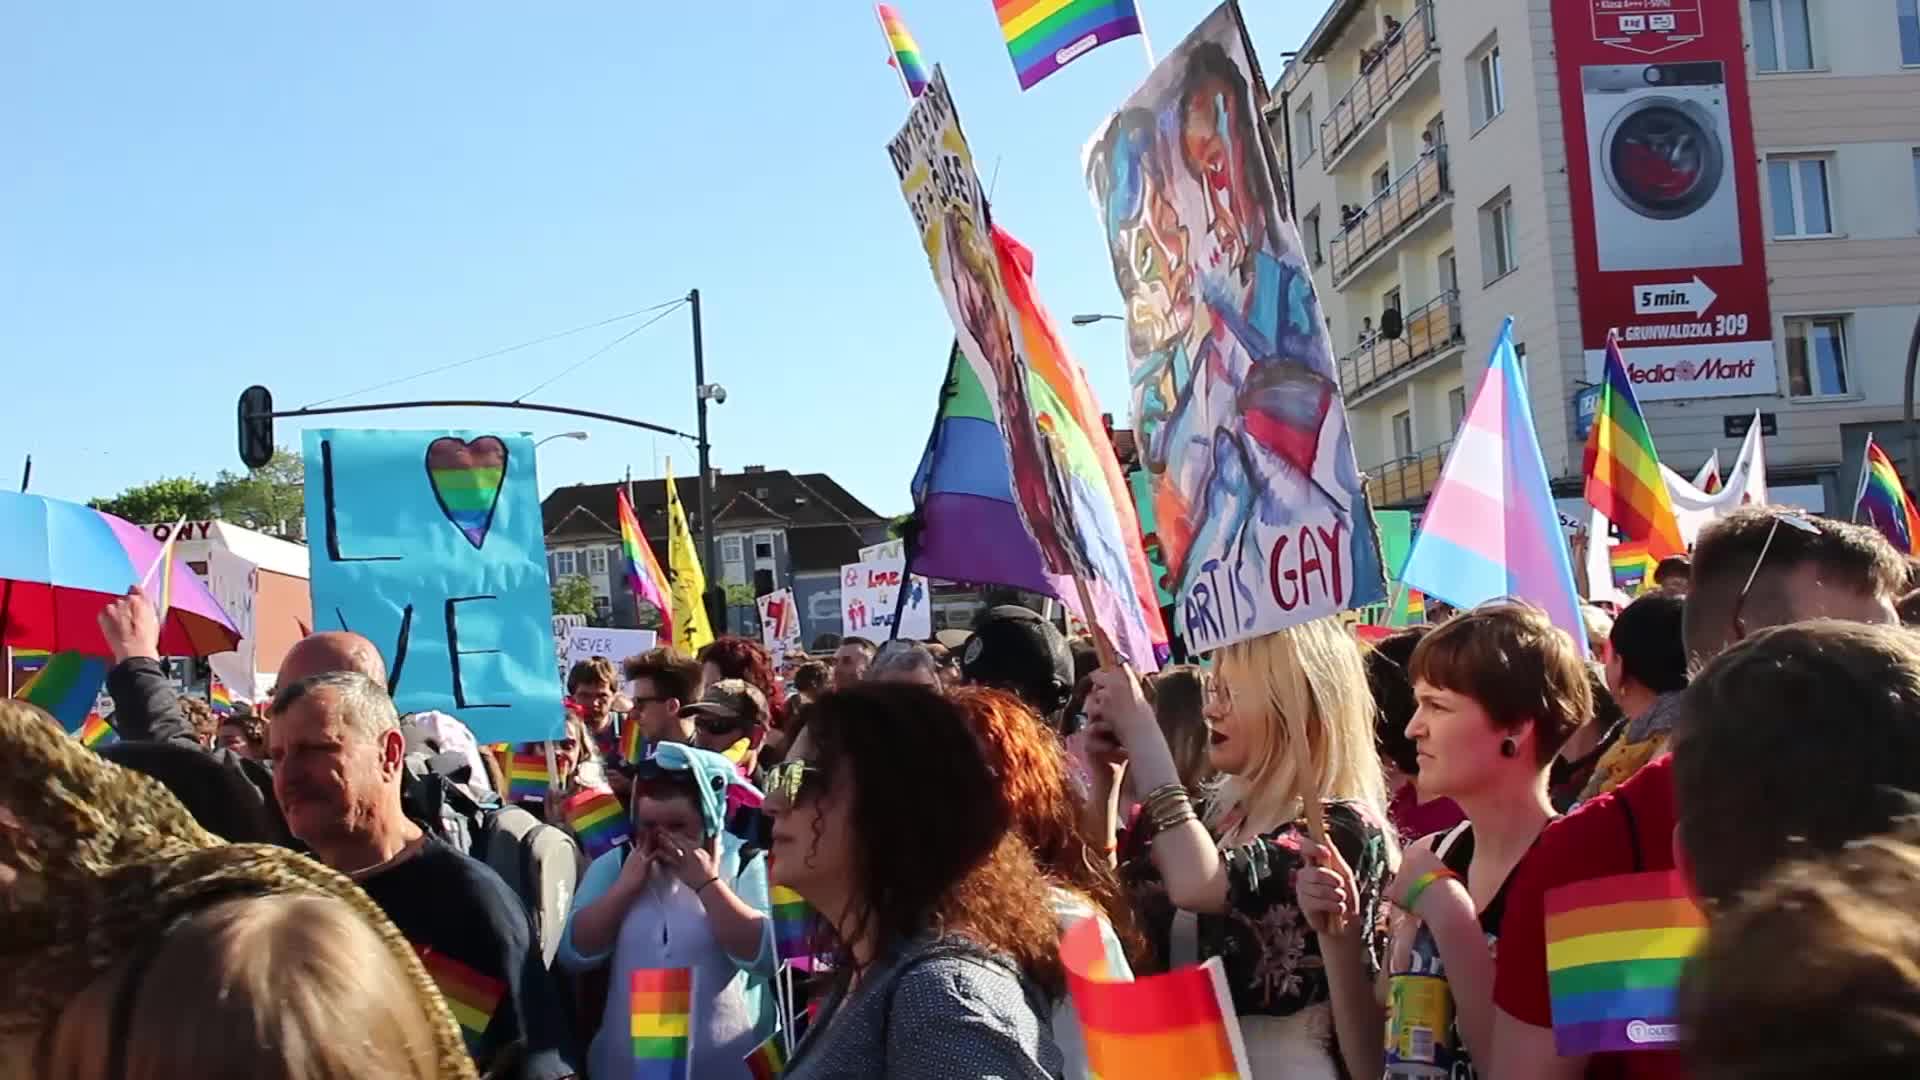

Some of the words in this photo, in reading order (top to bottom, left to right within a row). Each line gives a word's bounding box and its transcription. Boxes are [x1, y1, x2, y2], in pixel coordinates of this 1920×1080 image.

[1641, 291, 1652, 307] 5
[1653, 290, 1690, 306] min.
[1625, 322, 1713, 342] GRUNWALDZKA
[1714, 313, 1748, 337] 309
[1694, 357, 1755, 381] Markt
[1185, 559, 1226, 649] ART
[1228, 560, 1257, 634] IS
[1269, 519, 1343, 611] GAY
[569, 637, 613, 653] NEVER
